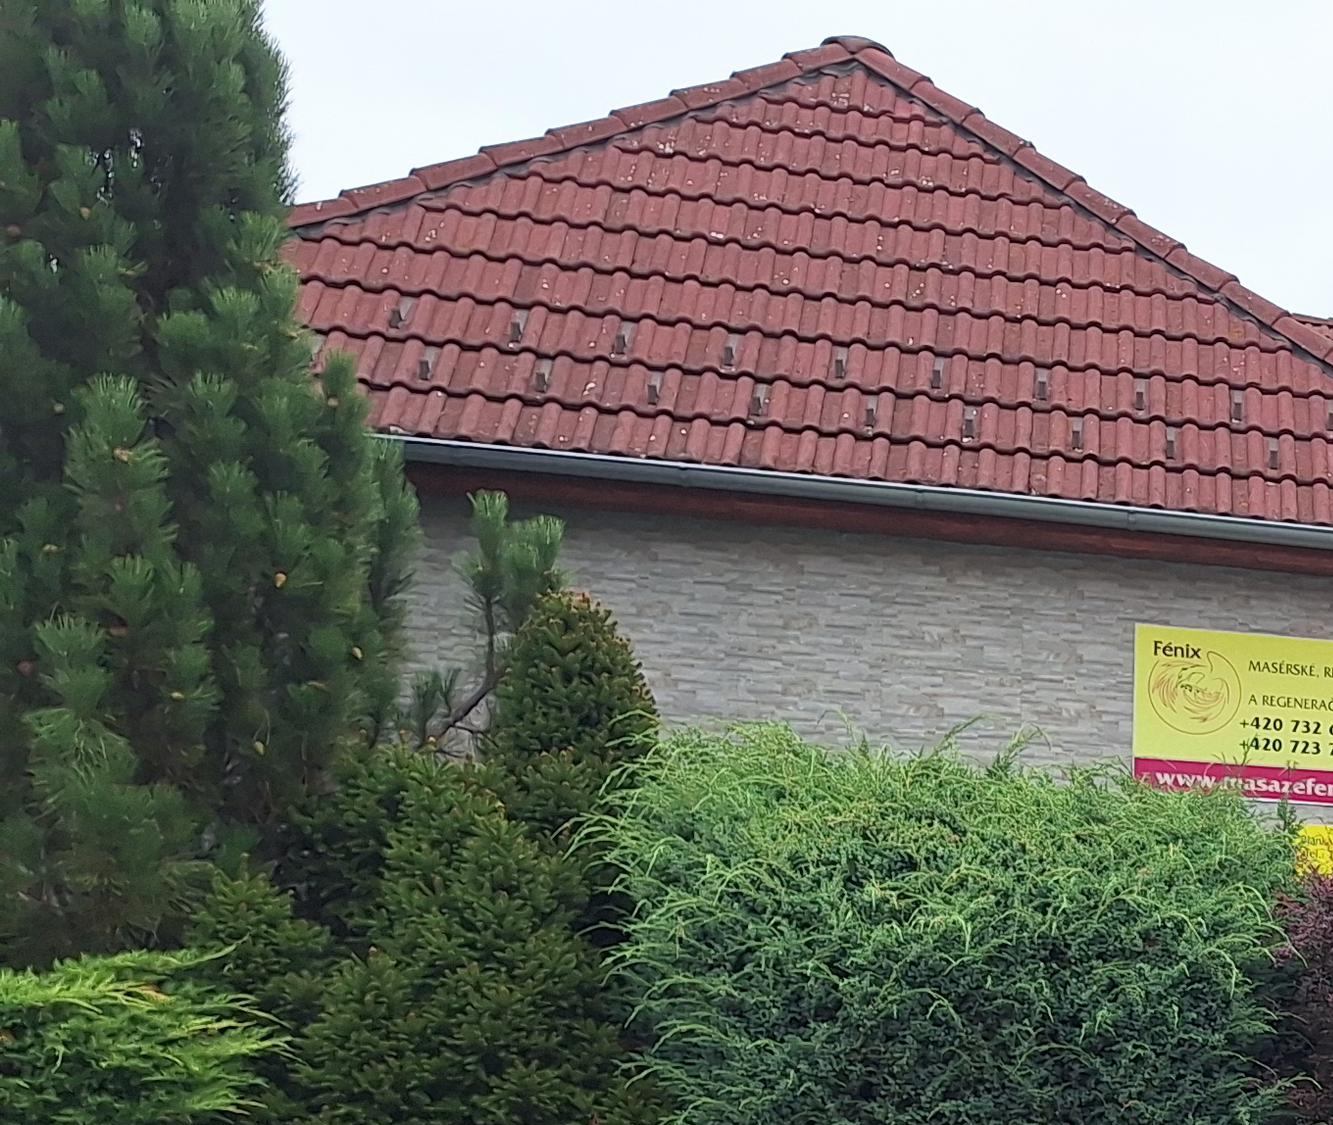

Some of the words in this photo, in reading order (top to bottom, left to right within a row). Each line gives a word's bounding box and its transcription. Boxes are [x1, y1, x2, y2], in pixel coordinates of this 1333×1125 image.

[1153, 640, 1202, 659] Fénix
[1248, 660, 1320, 678] MASÉRSKÉ,
[1248, 694, 1258, 706] A
[1239, 716, 1284, 732] +420
[1290, 719, 1322, 735] 732
[1239, 736, 1283, 753] +420
[1289, 740, 1322, 755] 723
